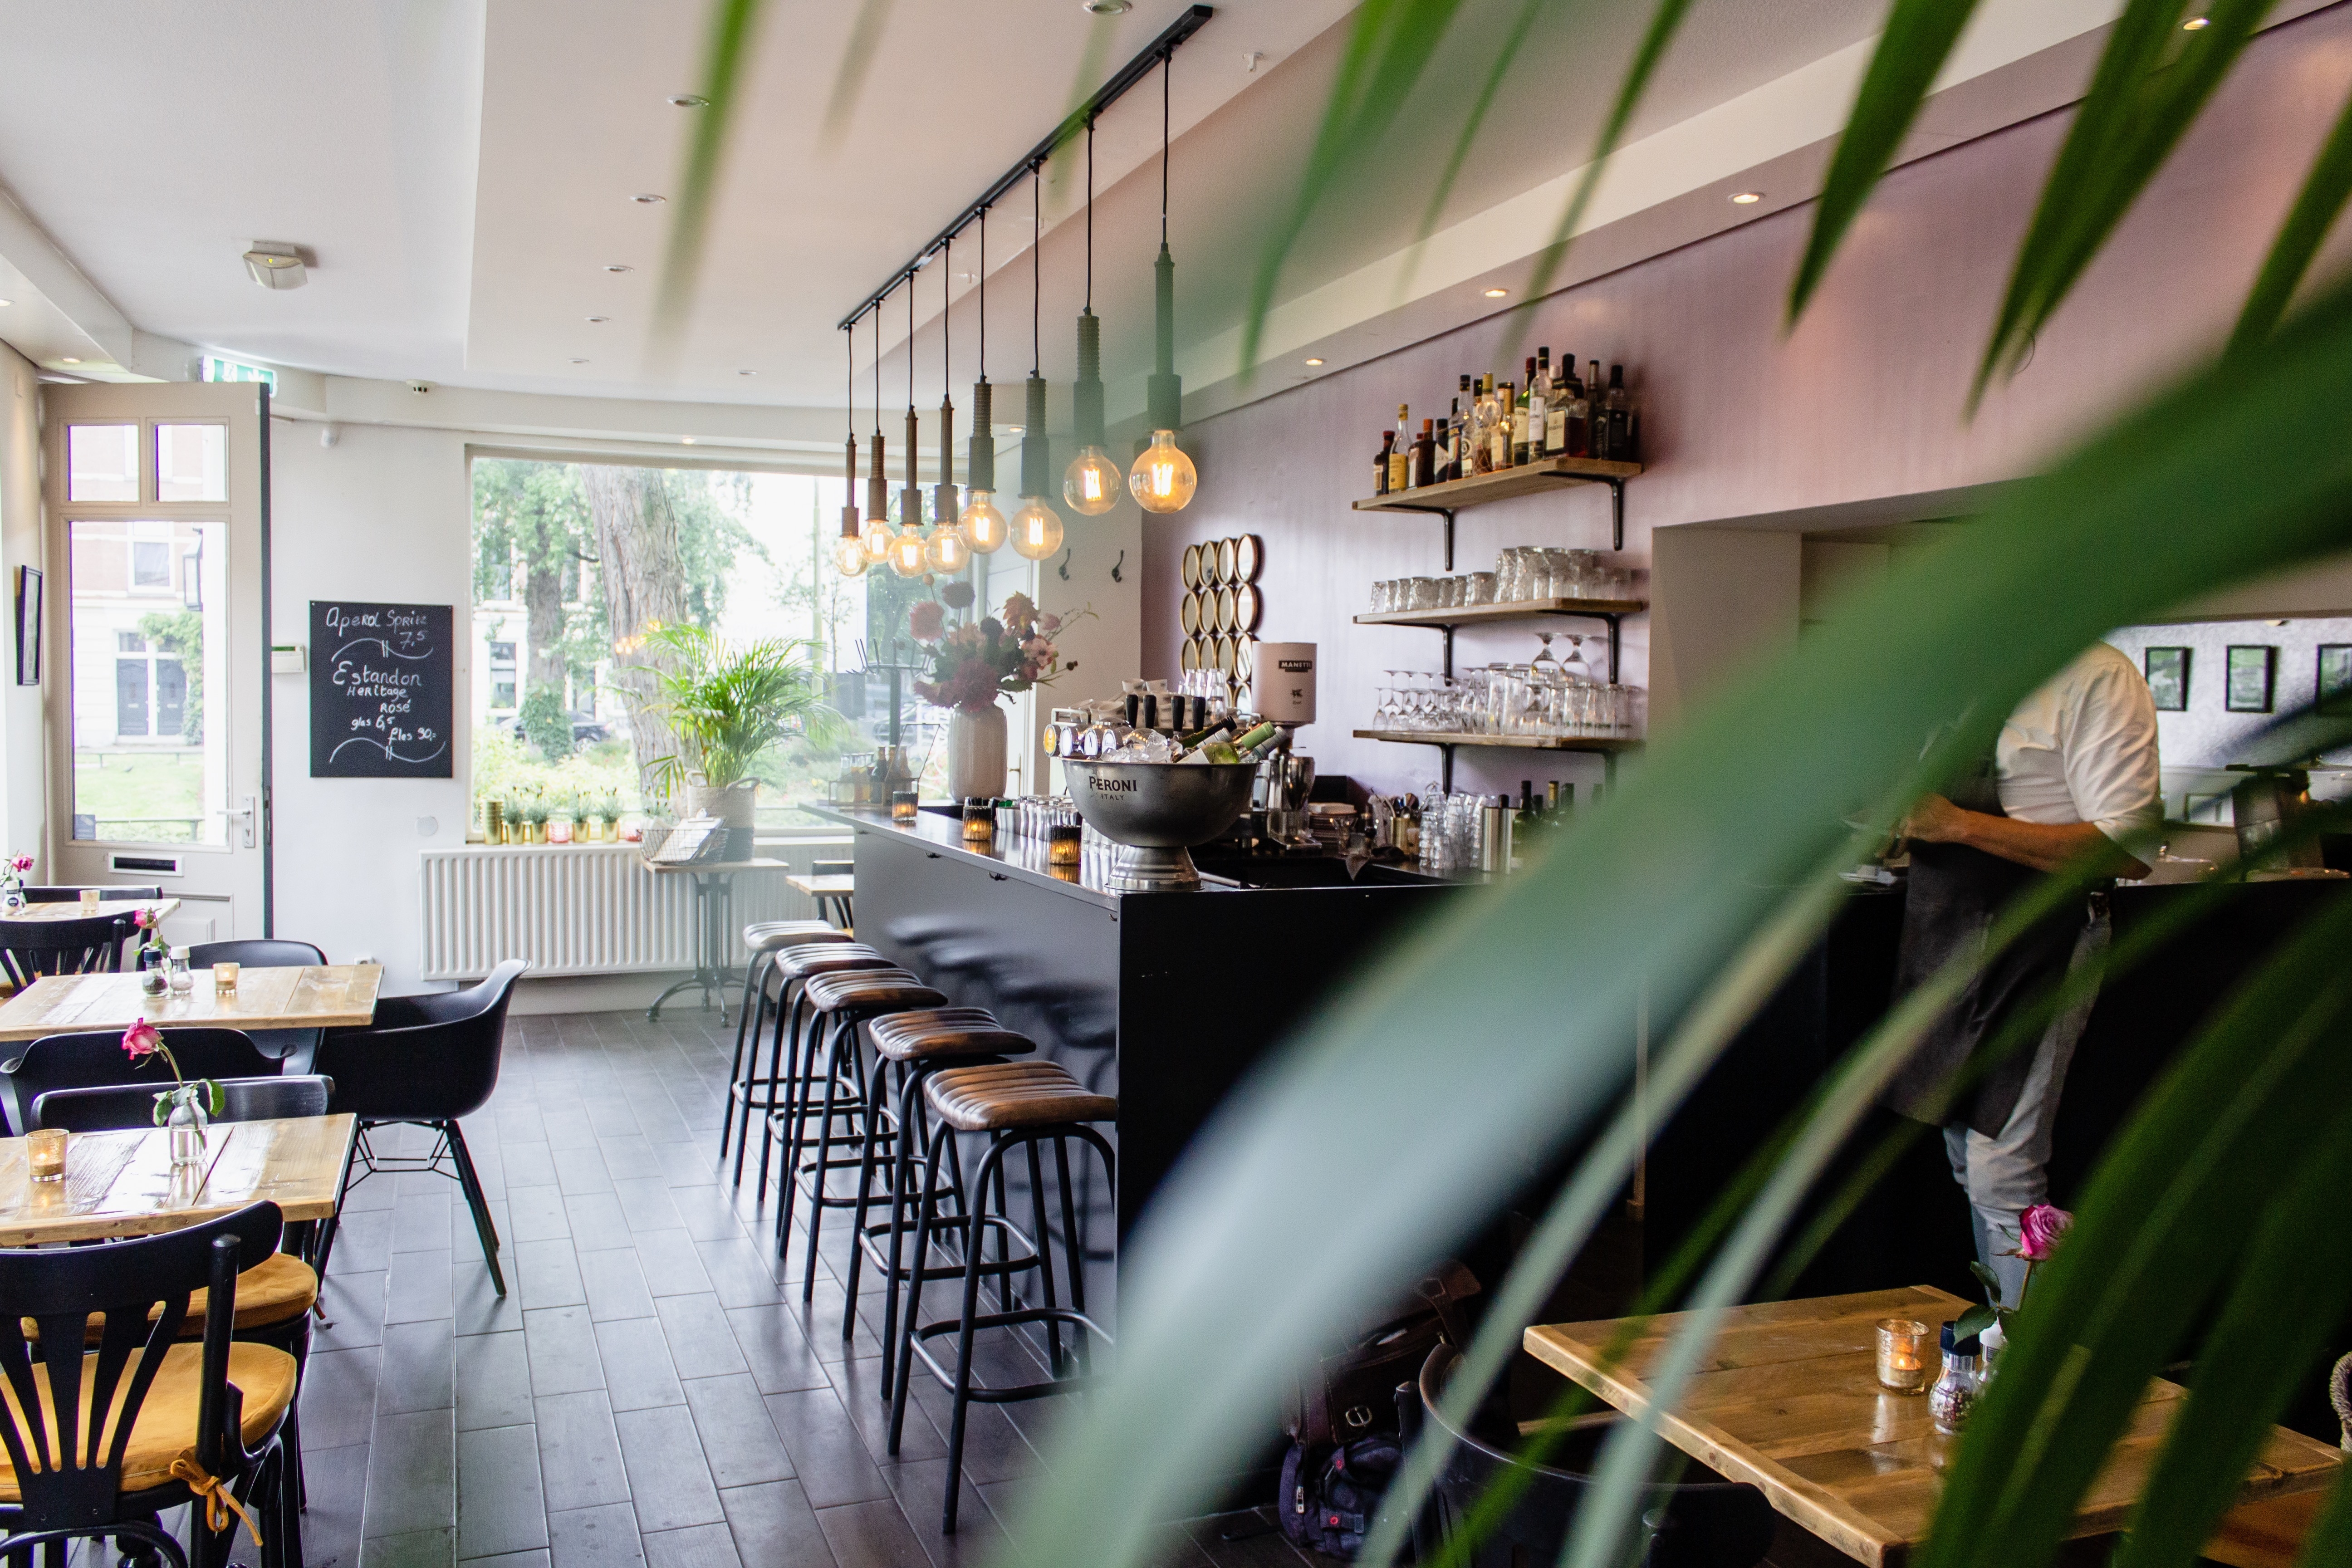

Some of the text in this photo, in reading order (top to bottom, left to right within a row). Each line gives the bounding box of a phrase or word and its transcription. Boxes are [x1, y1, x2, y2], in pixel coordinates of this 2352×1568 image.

[333, 661, 422, 686] Estandon
[347, 684, 408, 702] Heritage
[351, 716, 371, 731] glas
[1089, 776, 1137, 791] PERONI
